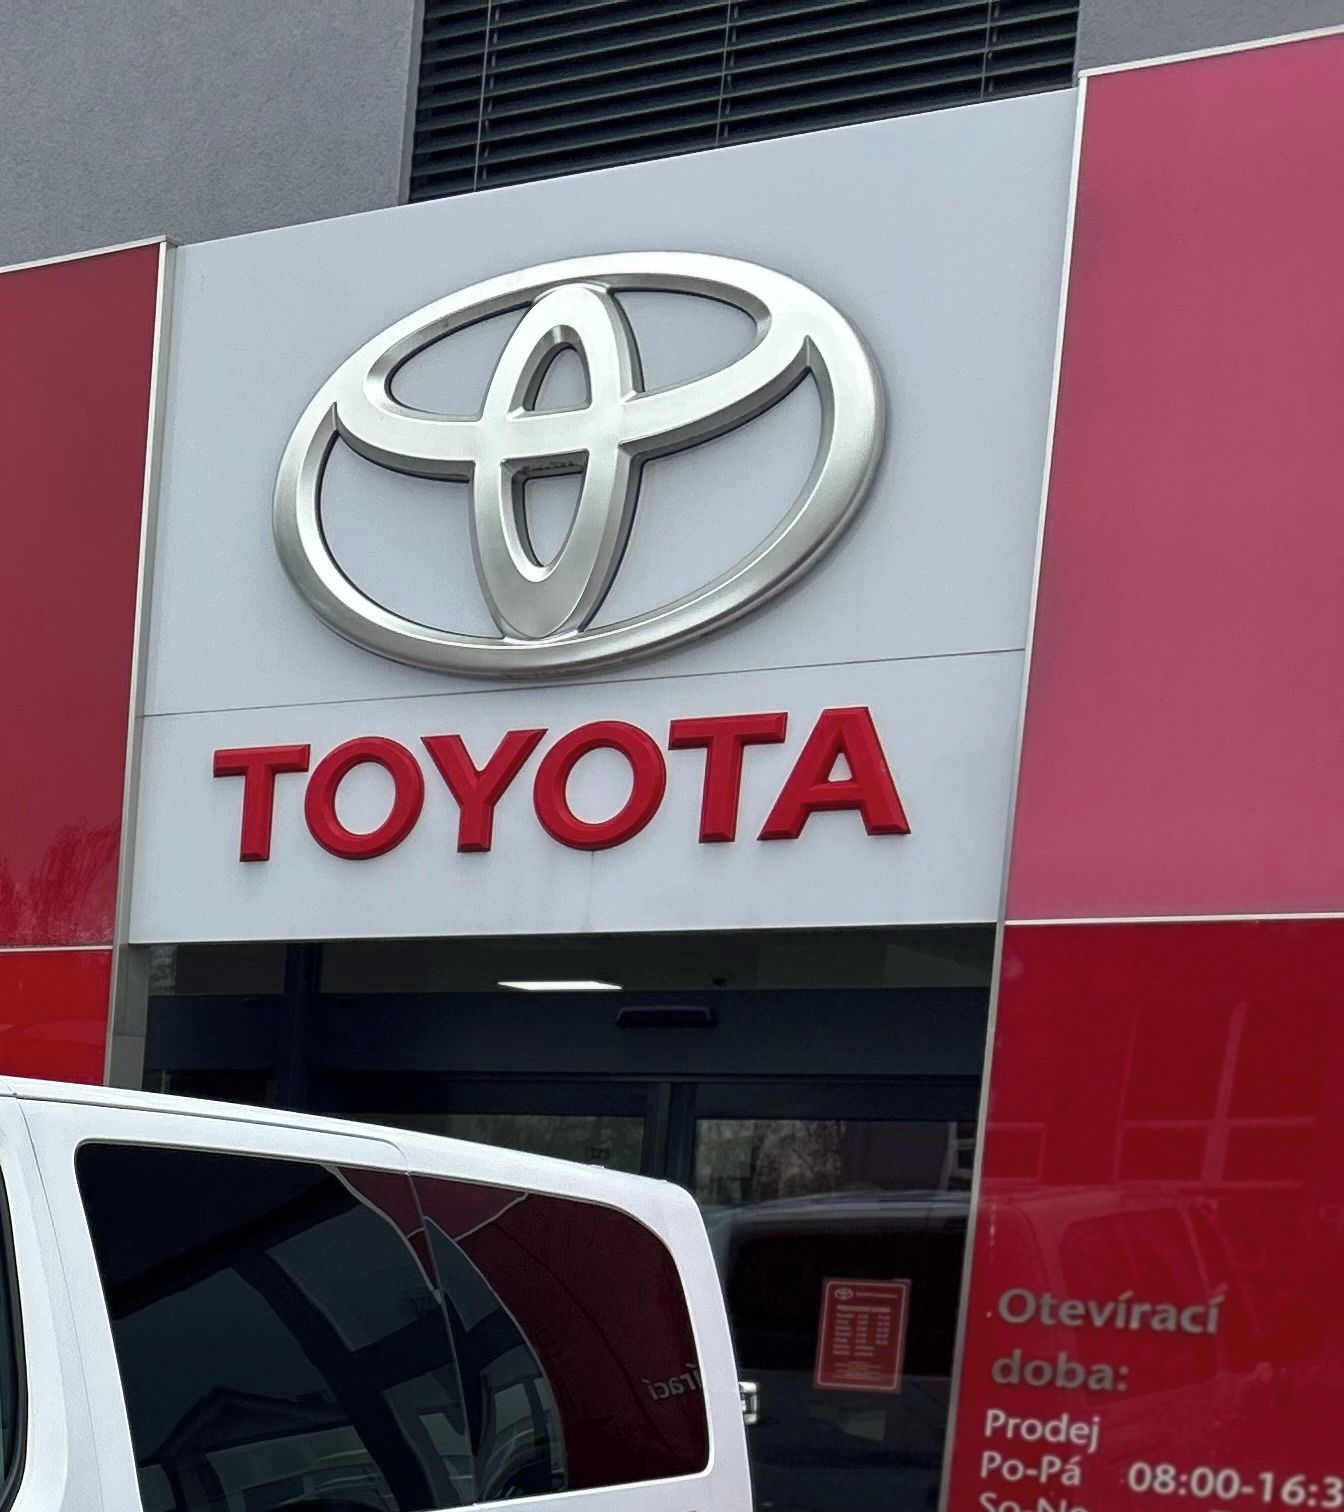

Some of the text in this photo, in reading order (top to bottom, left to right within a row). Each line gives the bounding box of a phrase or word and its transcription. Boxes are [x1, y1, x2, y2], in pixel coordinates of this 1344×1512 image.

[213, 706, 912, 863] TOYOTA
[997, 1284, 1228, 1335] Otevírací
[991, 1348, 1130, 1392] doba:
[983, 1408, 1101, 1454] Prodej
[979, 1450, 1083, 1487] Po-Pá
